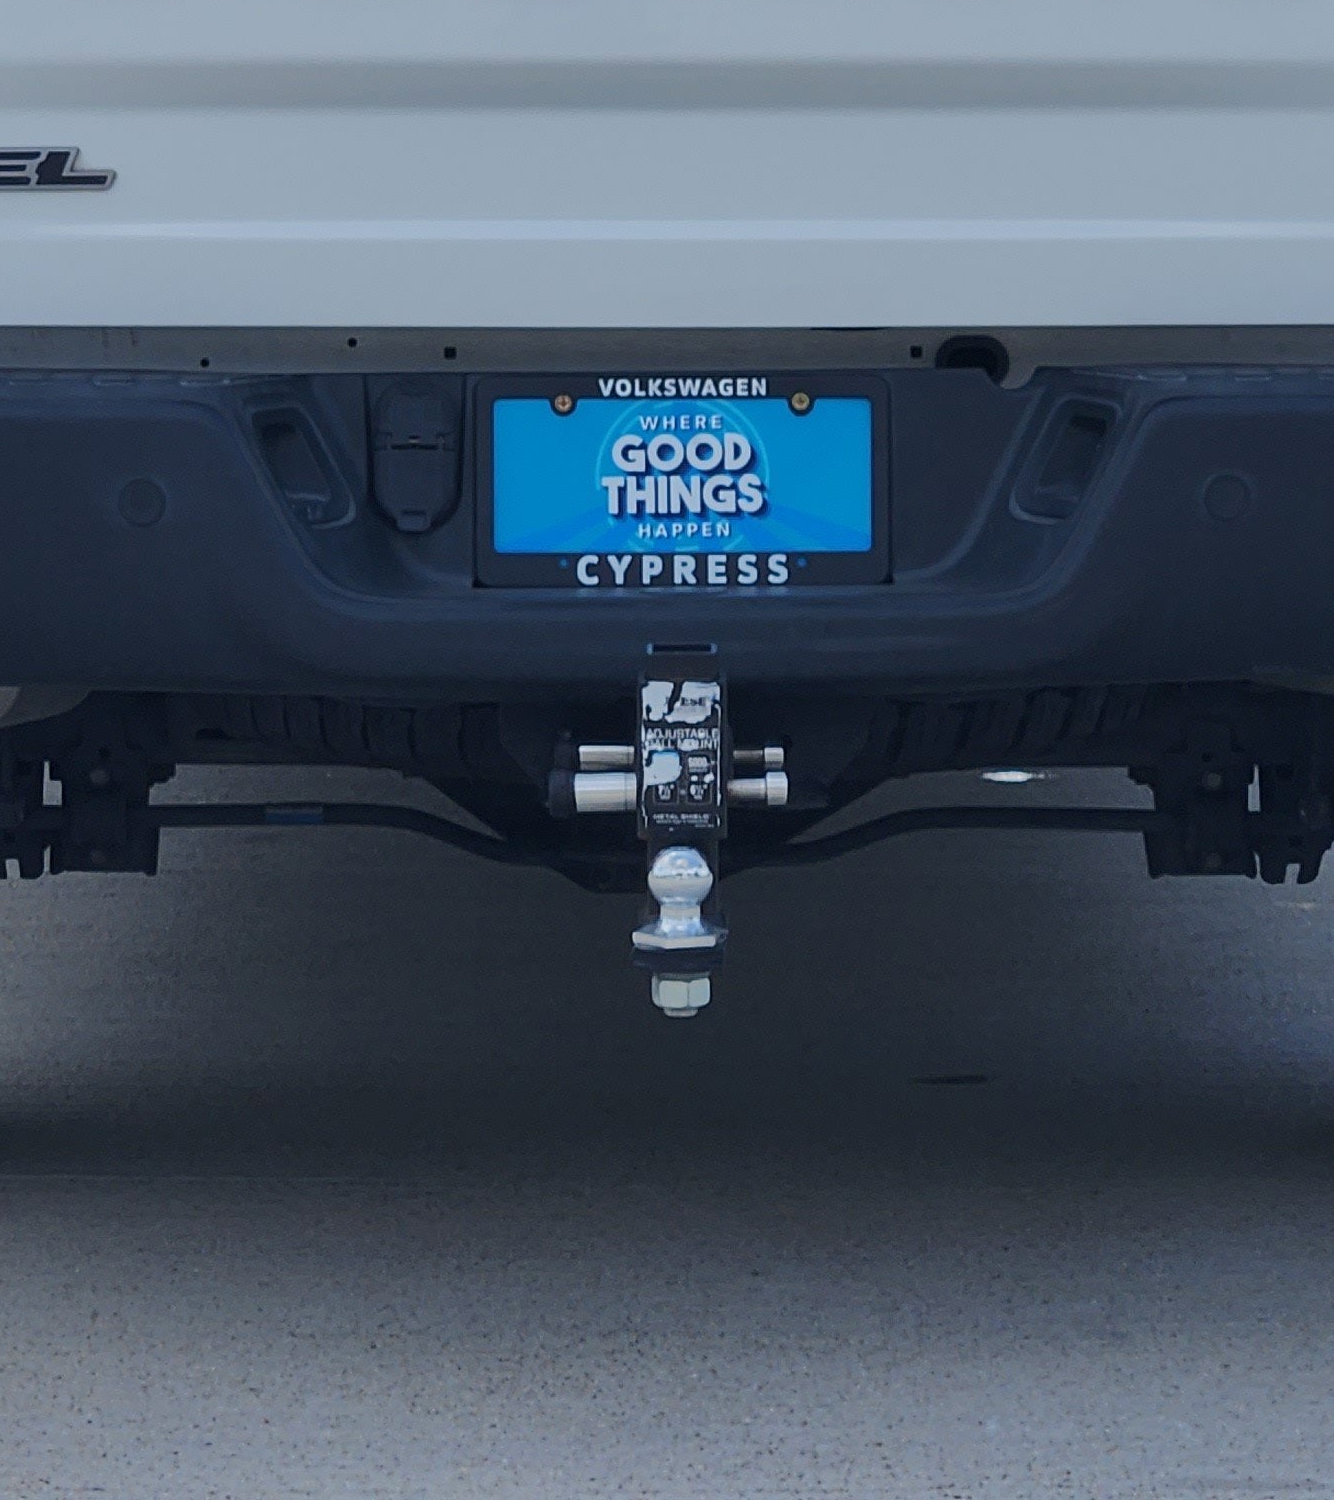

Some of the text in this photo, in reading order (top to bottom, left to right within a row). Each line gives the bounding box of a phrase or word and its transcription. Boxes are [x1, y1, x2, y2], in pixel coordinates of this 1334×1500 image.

[598, 378, 767, 397] VOLKSWAGEN
[639, 415, 723, 430] WHERE
[612, 433, 752, 473] GOOD
[601, 474, 765, 515] THINGS
[638, 522, 730, 538] HAPPEN
[576, 554, 789, 586] CYPRESS
[677, 739, 718, 750] MUNT
